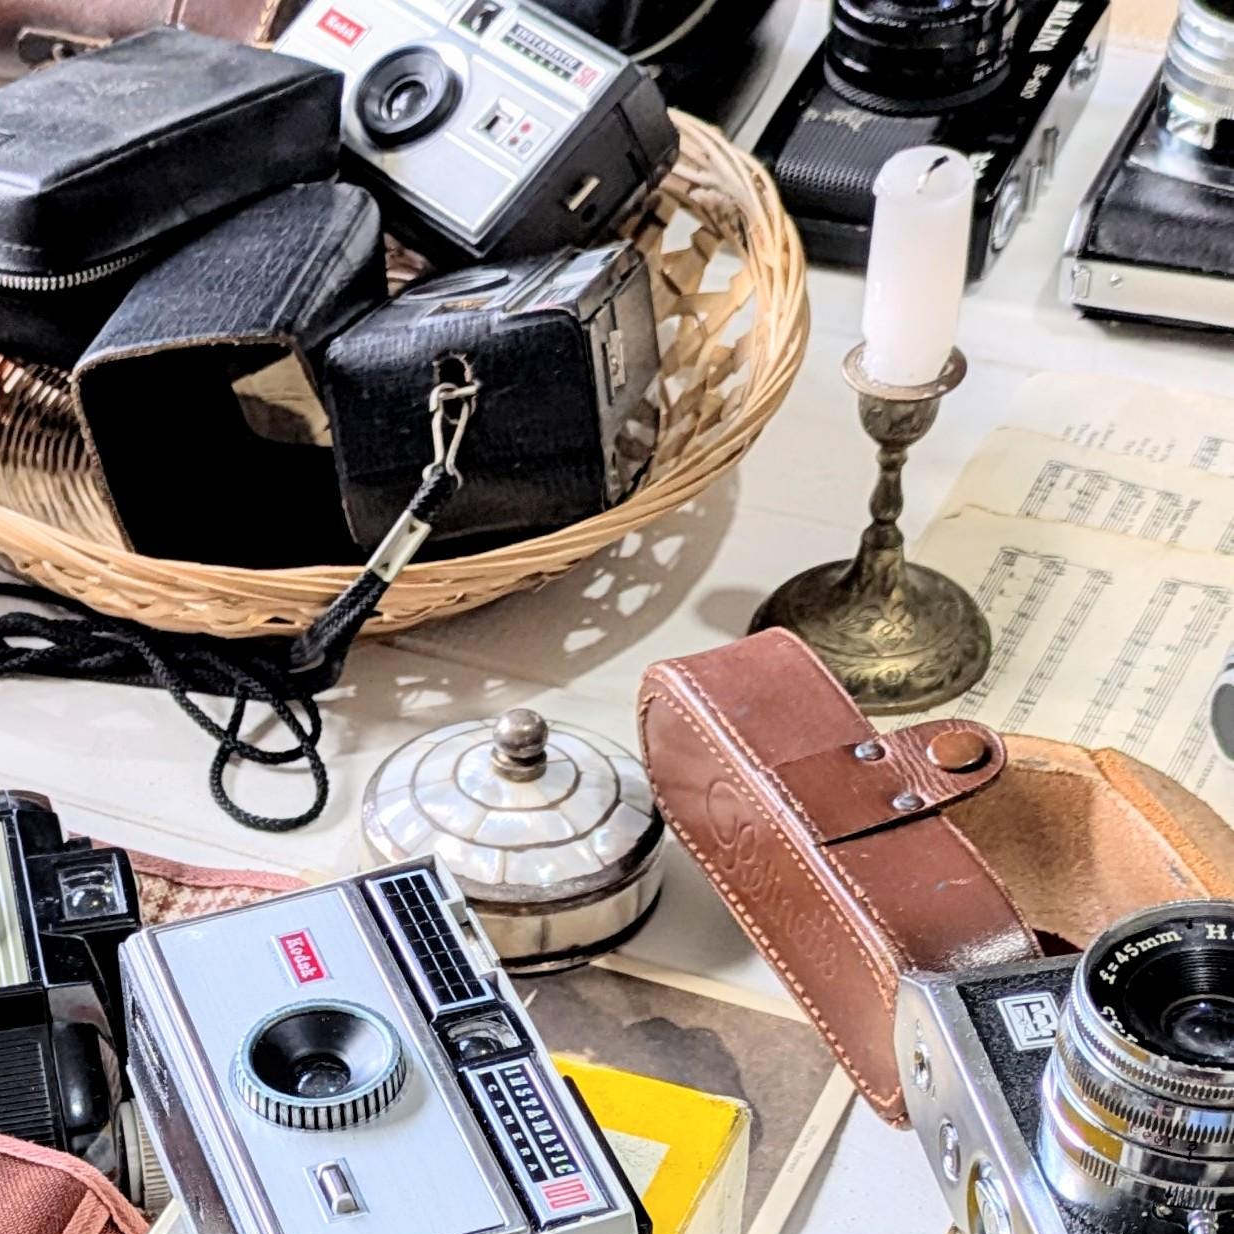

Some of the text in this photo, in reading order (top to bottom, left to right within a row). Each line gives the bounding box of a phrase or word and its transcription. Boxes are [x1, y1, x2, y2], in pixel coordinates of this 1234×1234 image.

[286, 937, 318, 979] Kodak
[487, 1083, 539, 1172] CAMERA
[504, 1068, 576, 1175] INSTAMATIC
[541, 1178, 591, 1210] 100
